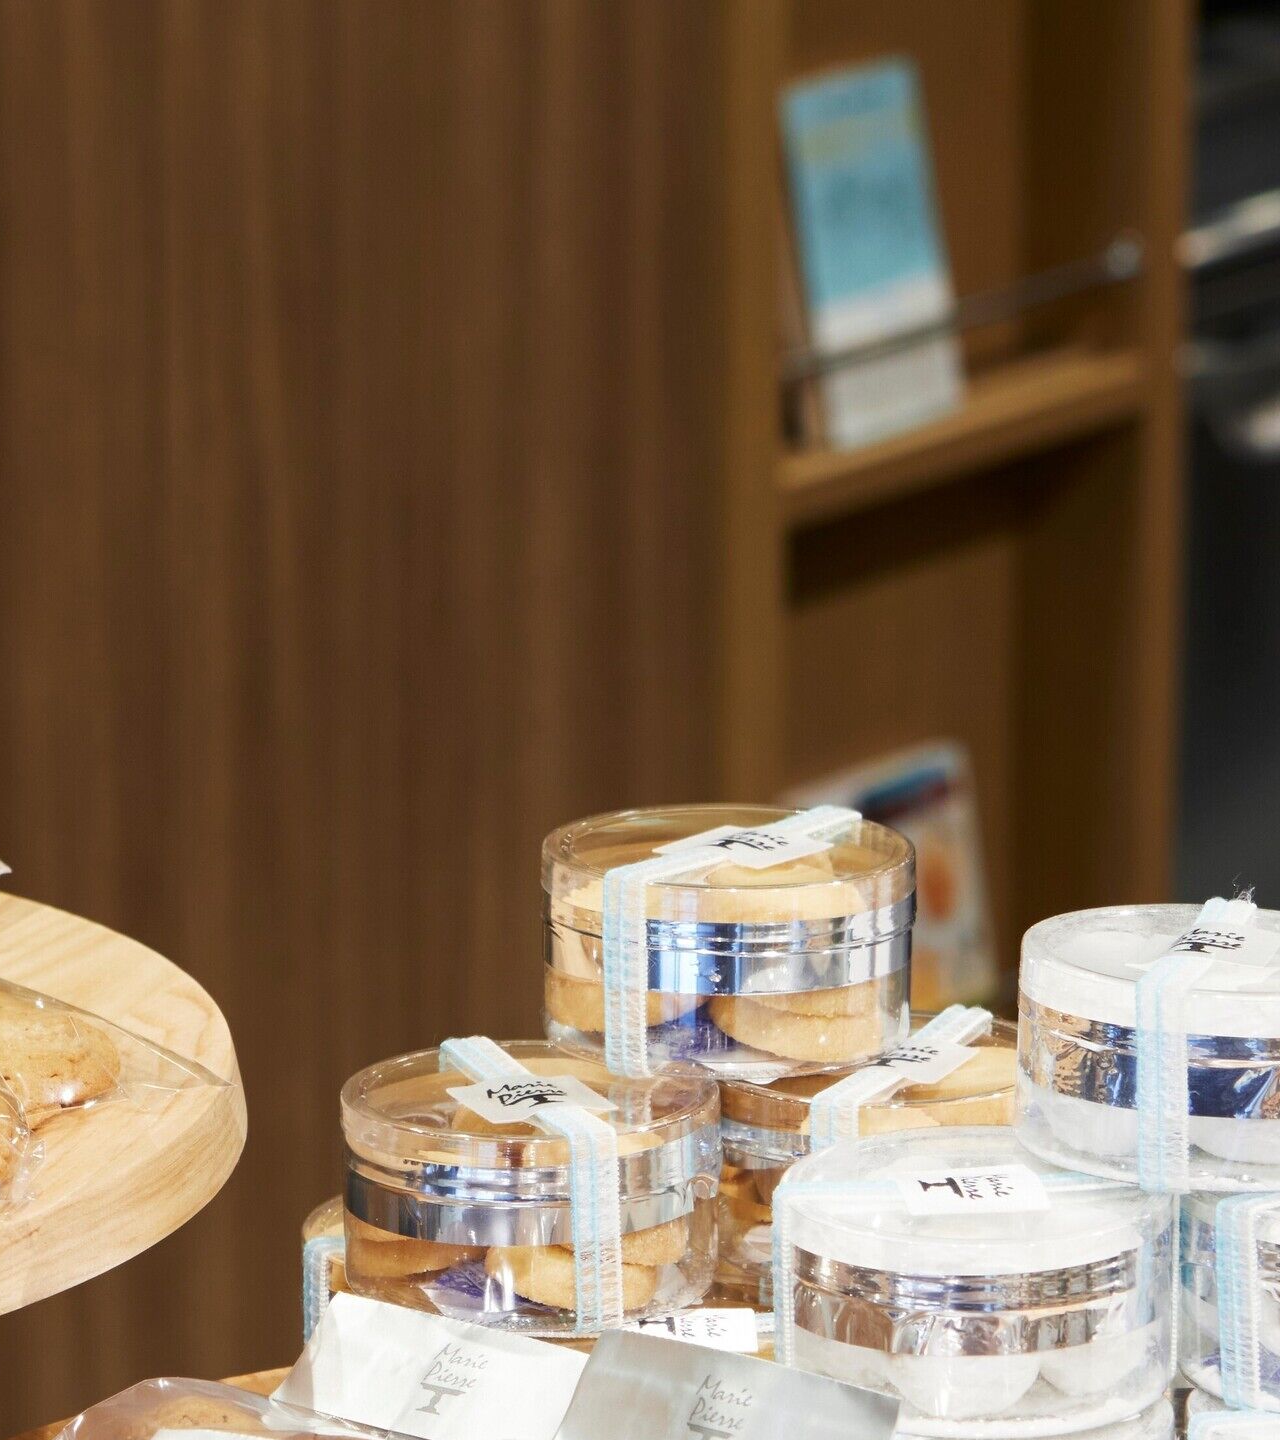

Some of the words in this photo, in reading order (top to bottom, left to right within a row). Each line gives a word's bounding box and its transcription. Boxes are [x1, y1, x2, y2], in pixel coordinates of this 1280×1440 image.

[487, 1081, 558, 1098] Marie
[434, 1342, 489, 1370] Marie
[423, 1361, 477, 1388] Pierre
[696, 1374, 753, 1407] Marie
[689, 1397, 744, 1430] Pierre
